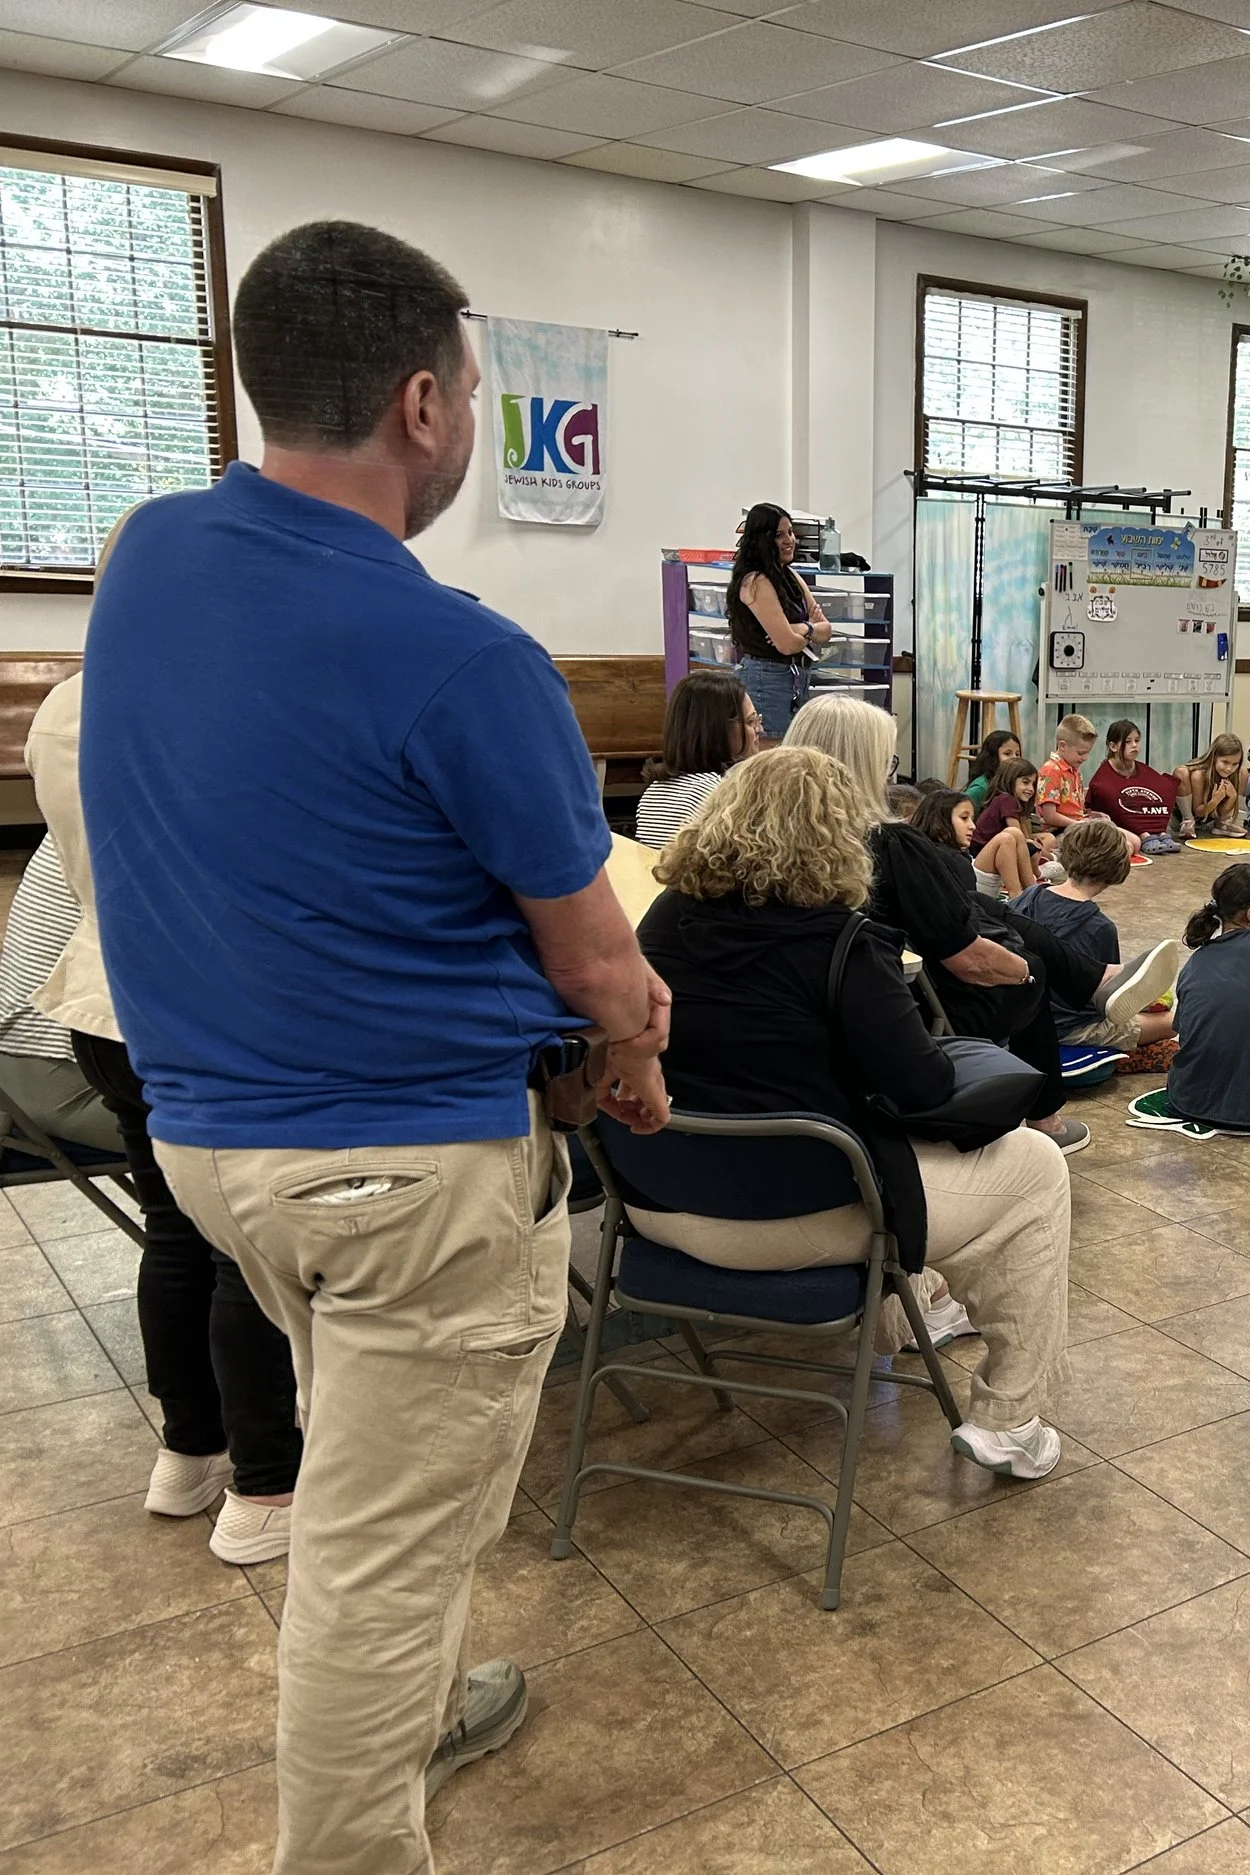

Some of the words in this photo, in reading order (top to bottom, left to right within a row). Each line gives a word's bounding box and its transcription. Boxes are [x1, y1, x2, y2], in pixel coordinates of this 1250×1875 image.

[501, 393, 600, 475] JKG
[505, 475, 537, 486] JEWISH
[541, 478, 562, 488] KIDS
[566, 480, 600, 490] GROUPS
[1202, 563, 1226, 576] 5785
